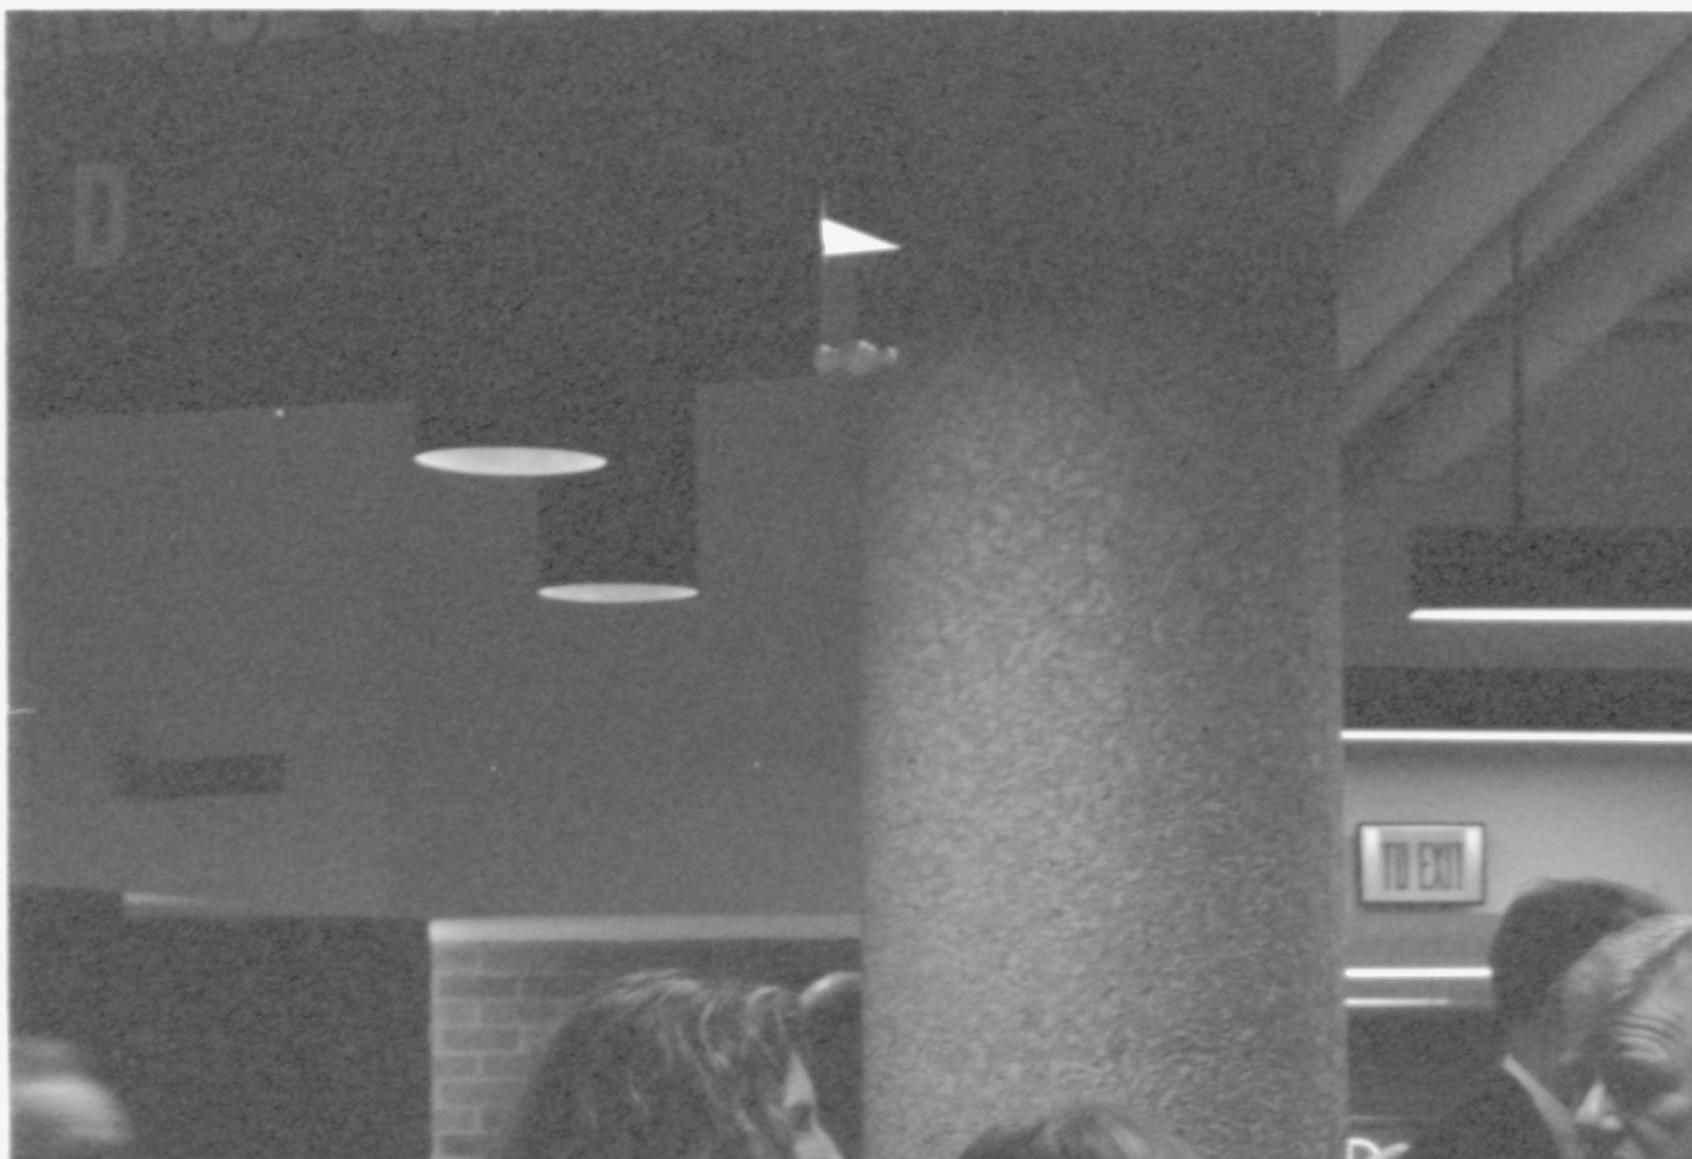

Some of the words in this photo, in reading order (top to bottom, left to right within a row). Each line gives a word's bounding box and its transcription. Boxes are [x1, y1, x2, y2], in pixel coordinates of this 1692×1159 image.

[74, 162, 126, 268] D
[1382, 841, 1409, 891] TO
[1418, 841, 1464, 891] EXIT
